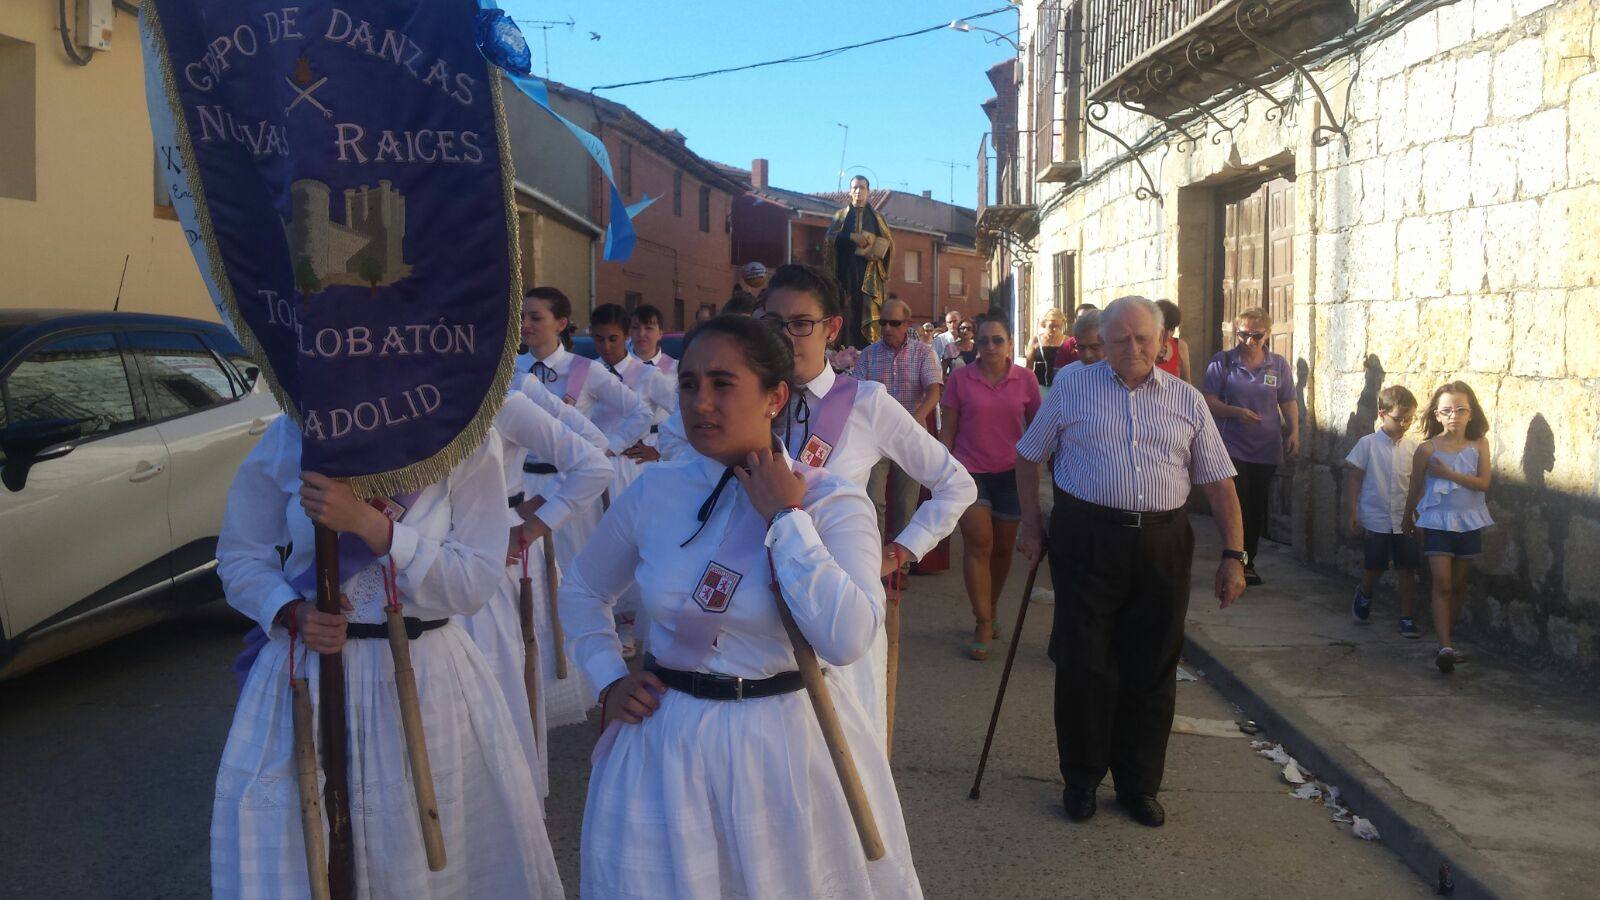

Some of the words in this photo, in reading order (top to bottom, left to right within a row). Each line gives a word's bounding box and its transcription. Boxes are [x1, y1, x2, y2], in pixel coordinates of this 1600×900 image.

[185, 24, 257, 91] GPO
[264, 7, 304, 43] DE
[325, 9, 475, 105] DANZAS
[196, 105, 290, 156] NUVAS
[334, 123, 483, 164] RAICES
